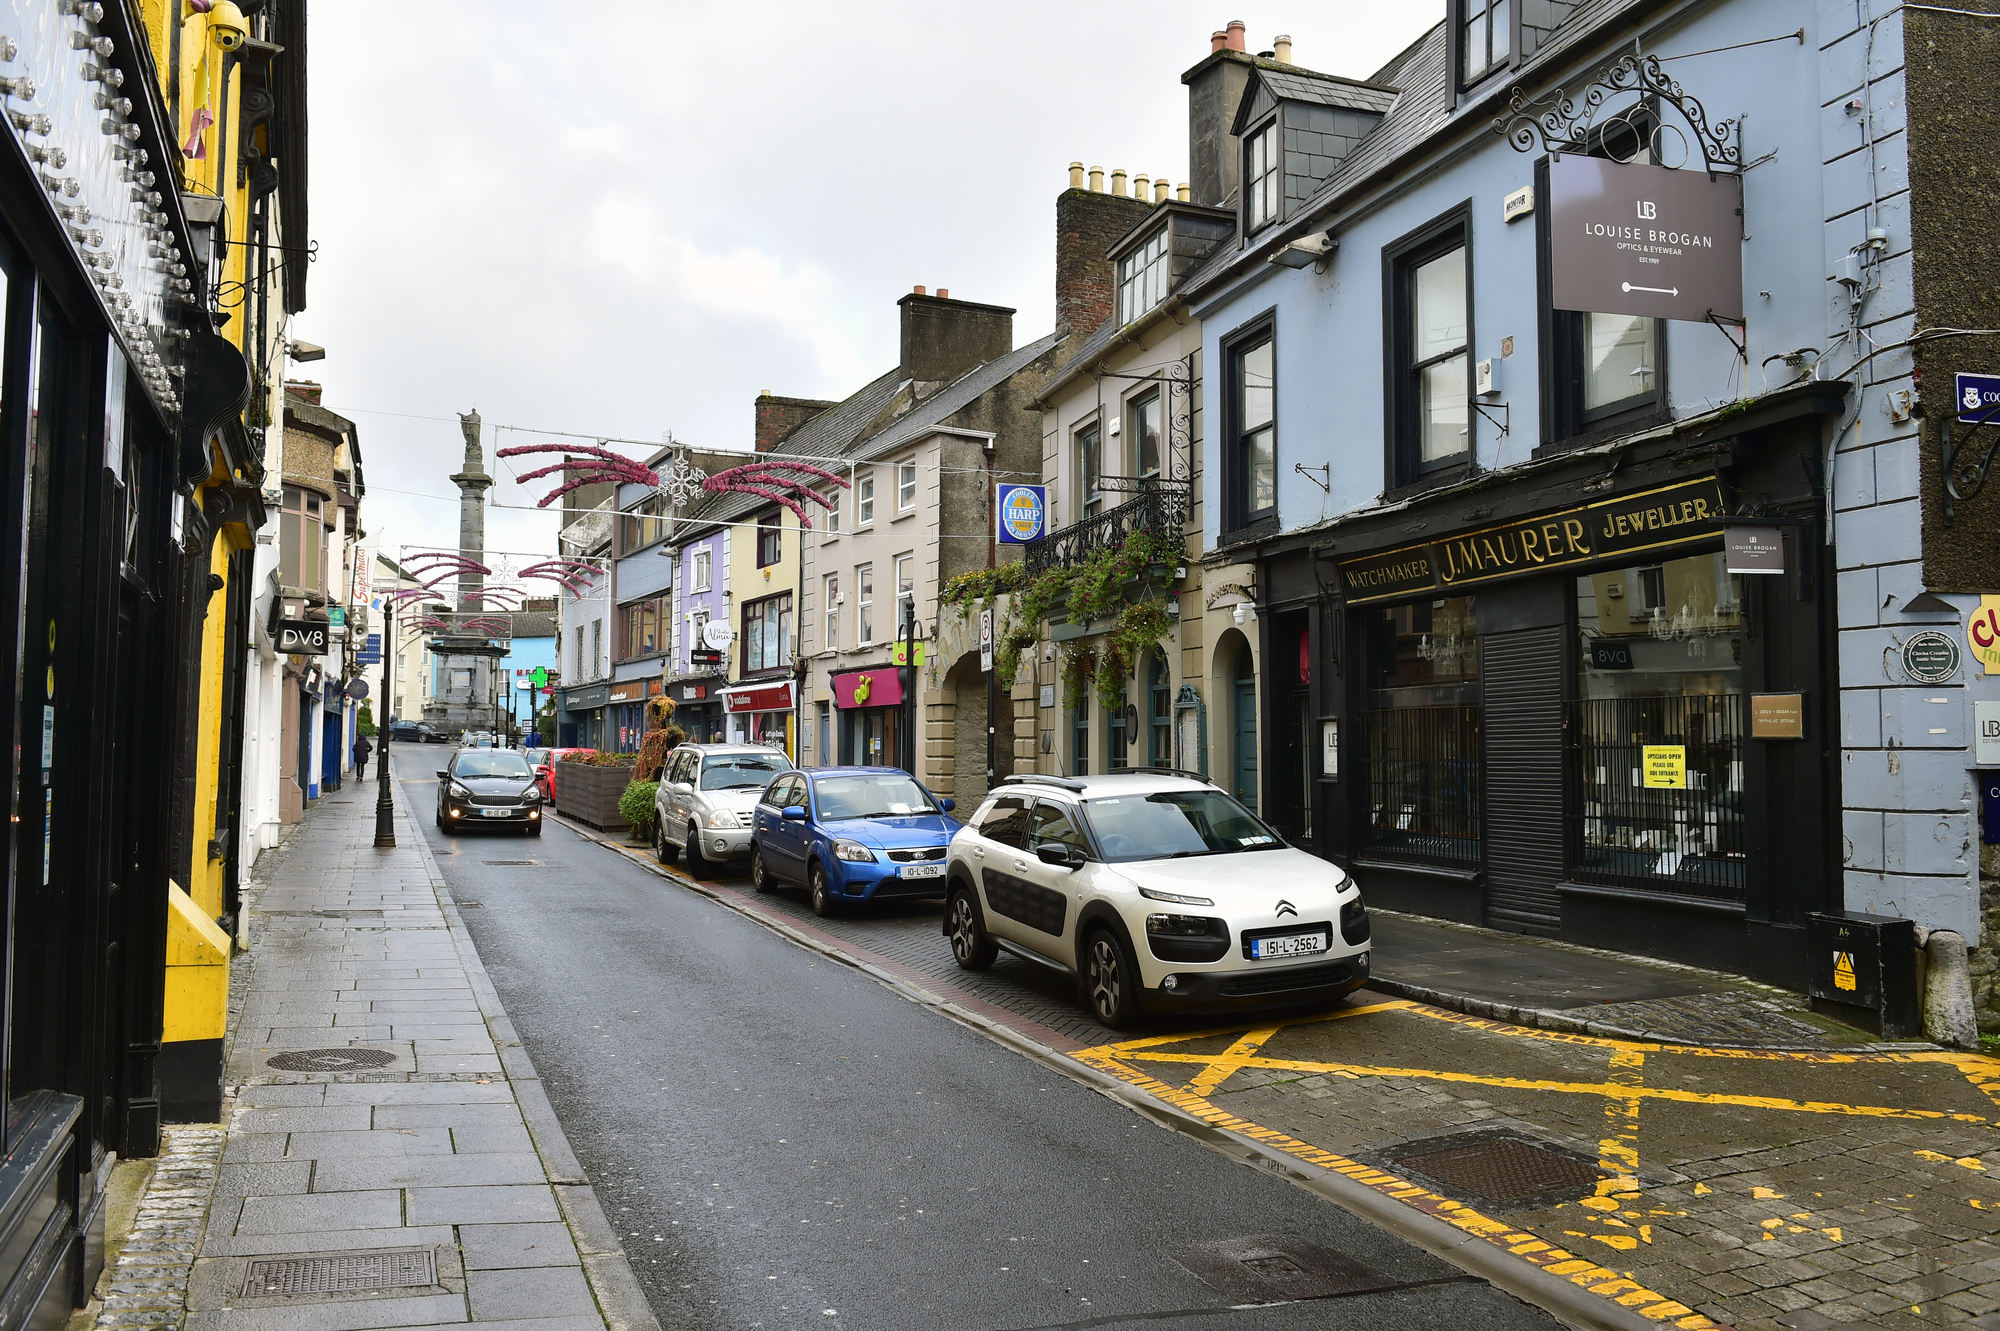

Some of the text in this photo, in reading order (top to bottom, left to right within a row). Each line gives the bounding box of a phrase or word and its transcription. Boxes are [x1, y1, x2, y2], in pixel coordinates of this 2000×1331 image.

[1506, 194, 1526, 214] MONITOR
[1585, 222, 1712, 248] LOUISE BROGAN
[1616, 242, 1683, 256] OPTICS & EYEWEAR
[1008, 508, 1040, 520] HARP
[1345, 558, 1429, 589] WATCHMAKER
[283, 629, 324, 646] DV8
[734, 692, 789, 705] vodafone Ennis
[907, 866, 938, 876] 10-L-1092
[1839, 927, 1850, 937] A4
[1266, 936, 1318, 955] 151-L-2562
[1835, 971, 1854, 979] Danger
